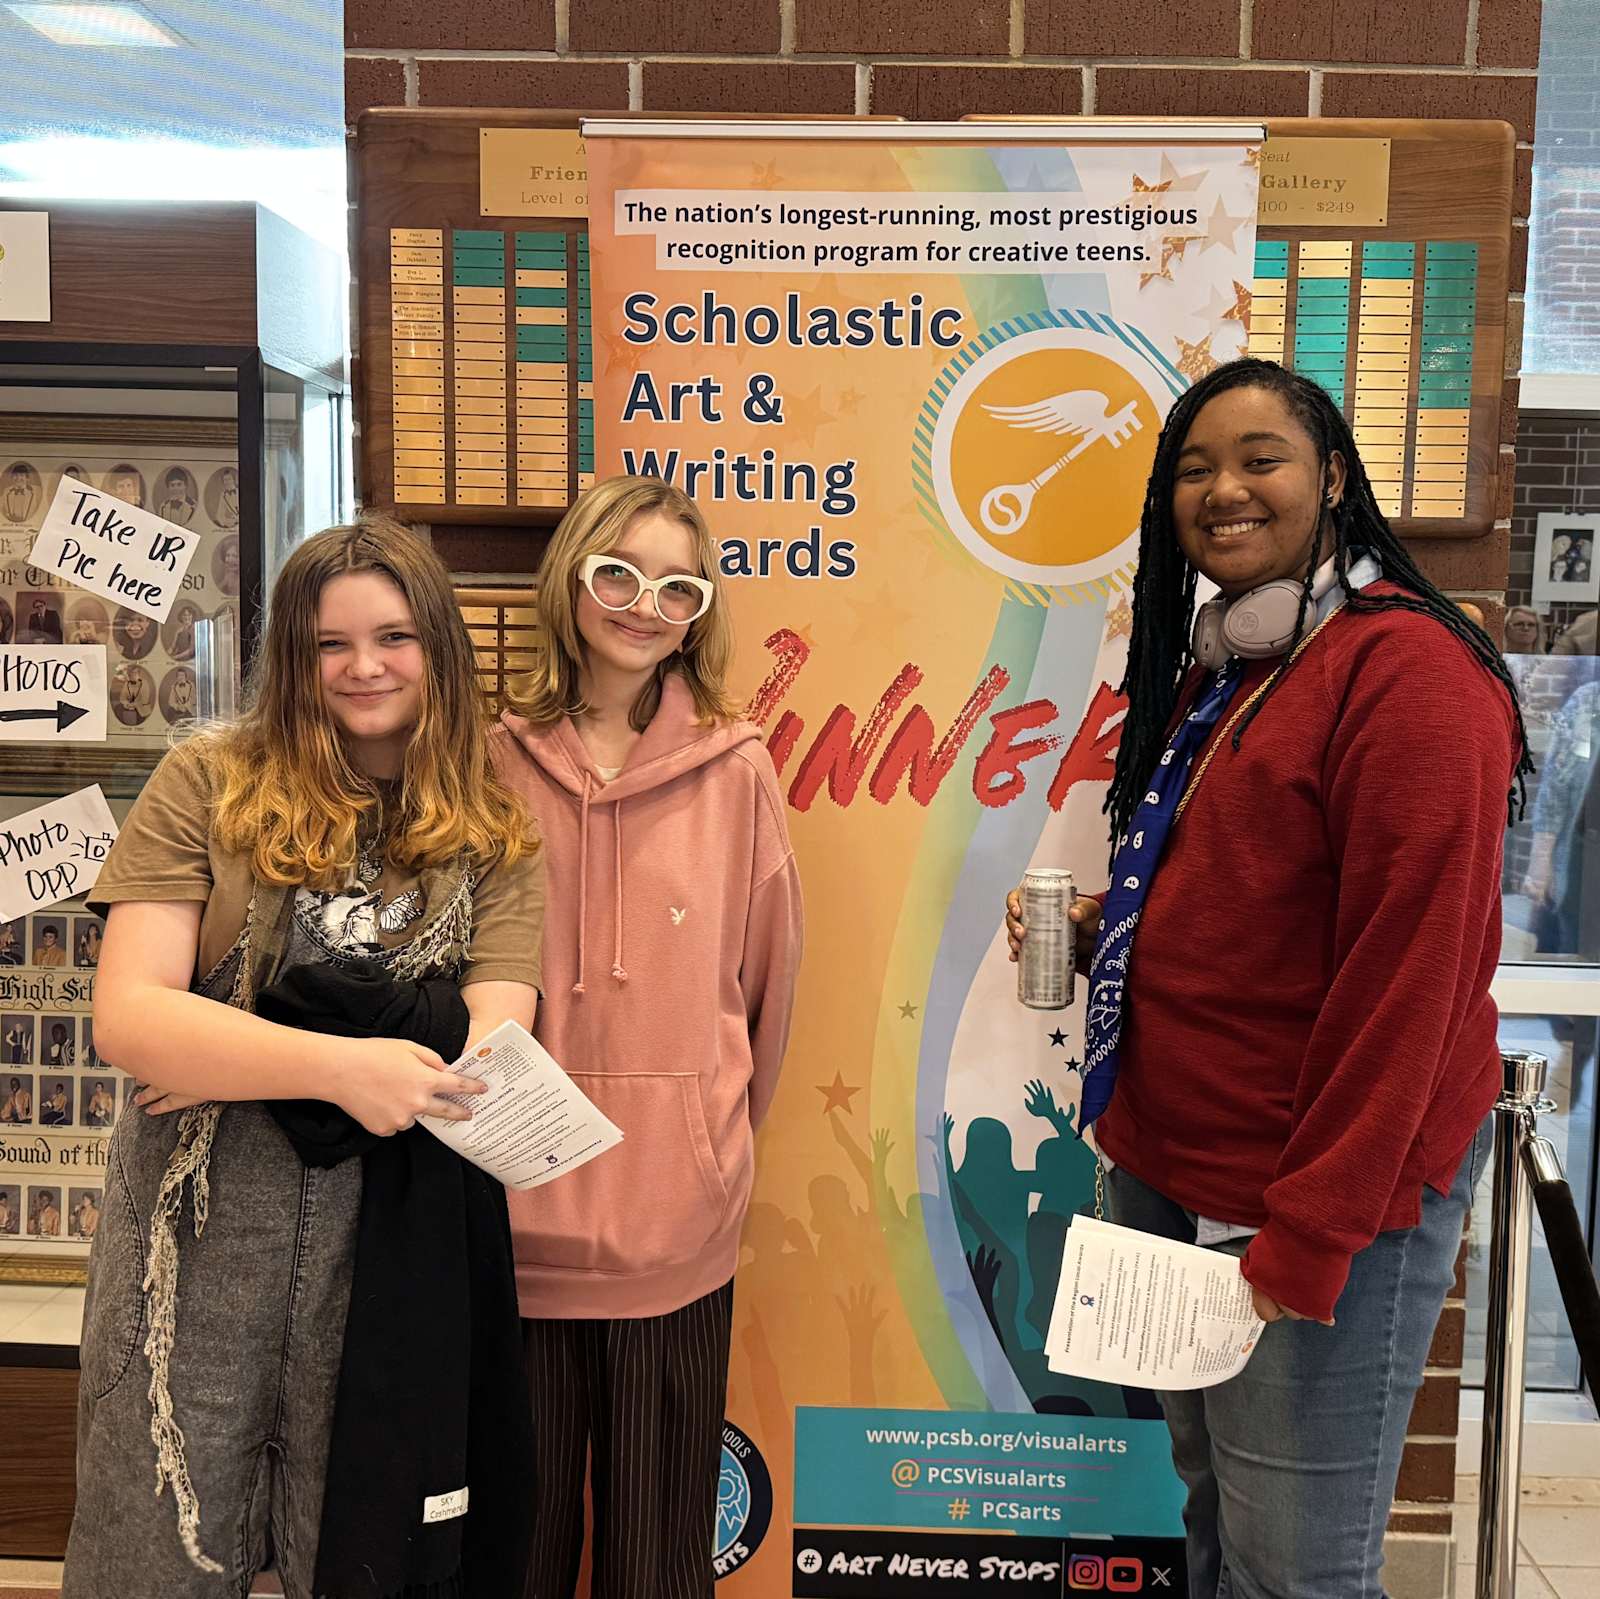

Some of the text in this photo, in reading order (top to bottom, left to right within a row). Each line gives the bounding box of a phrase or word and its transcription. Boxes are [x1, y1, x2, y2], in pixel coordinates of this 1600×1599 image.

[529, 166, 1347, 193] Frien Gallery
[521, 192, 563, 204] Level
[1316, 201, 1355, 213] $249
[625, 202, 1198, 231] The nation’s longest-running, most prestigious
[666, 239, 1151, 267] recognition program for creative teens.
[622, 291, 963, 347] Scholastic
[622, 373, 784, 423] Art &
[623, 448, 856, 515] Writing
[72, 490, 186, 572] Take UR
[719, 528, 856, 577] ards
[107, 563, 163, 607] here
[0, 654, 82, 694] HOTOS
[0, 819, 69, 866] Photo
[0, 973, 54, 1010] High
[60, 1144, 82, 1165] of
[85, 1139, 108, 1166] th
[722, 1427, 752, 1459] OOLS
[866, 1427, 1127, 1454] www.pcsb.org/visualarts
[891, 1459, 1067, 1489] @ PCSVisualarts
[948, 1498, 1062, 1522] # PCSarts
[712, 1541, 750, 1577] RTS
